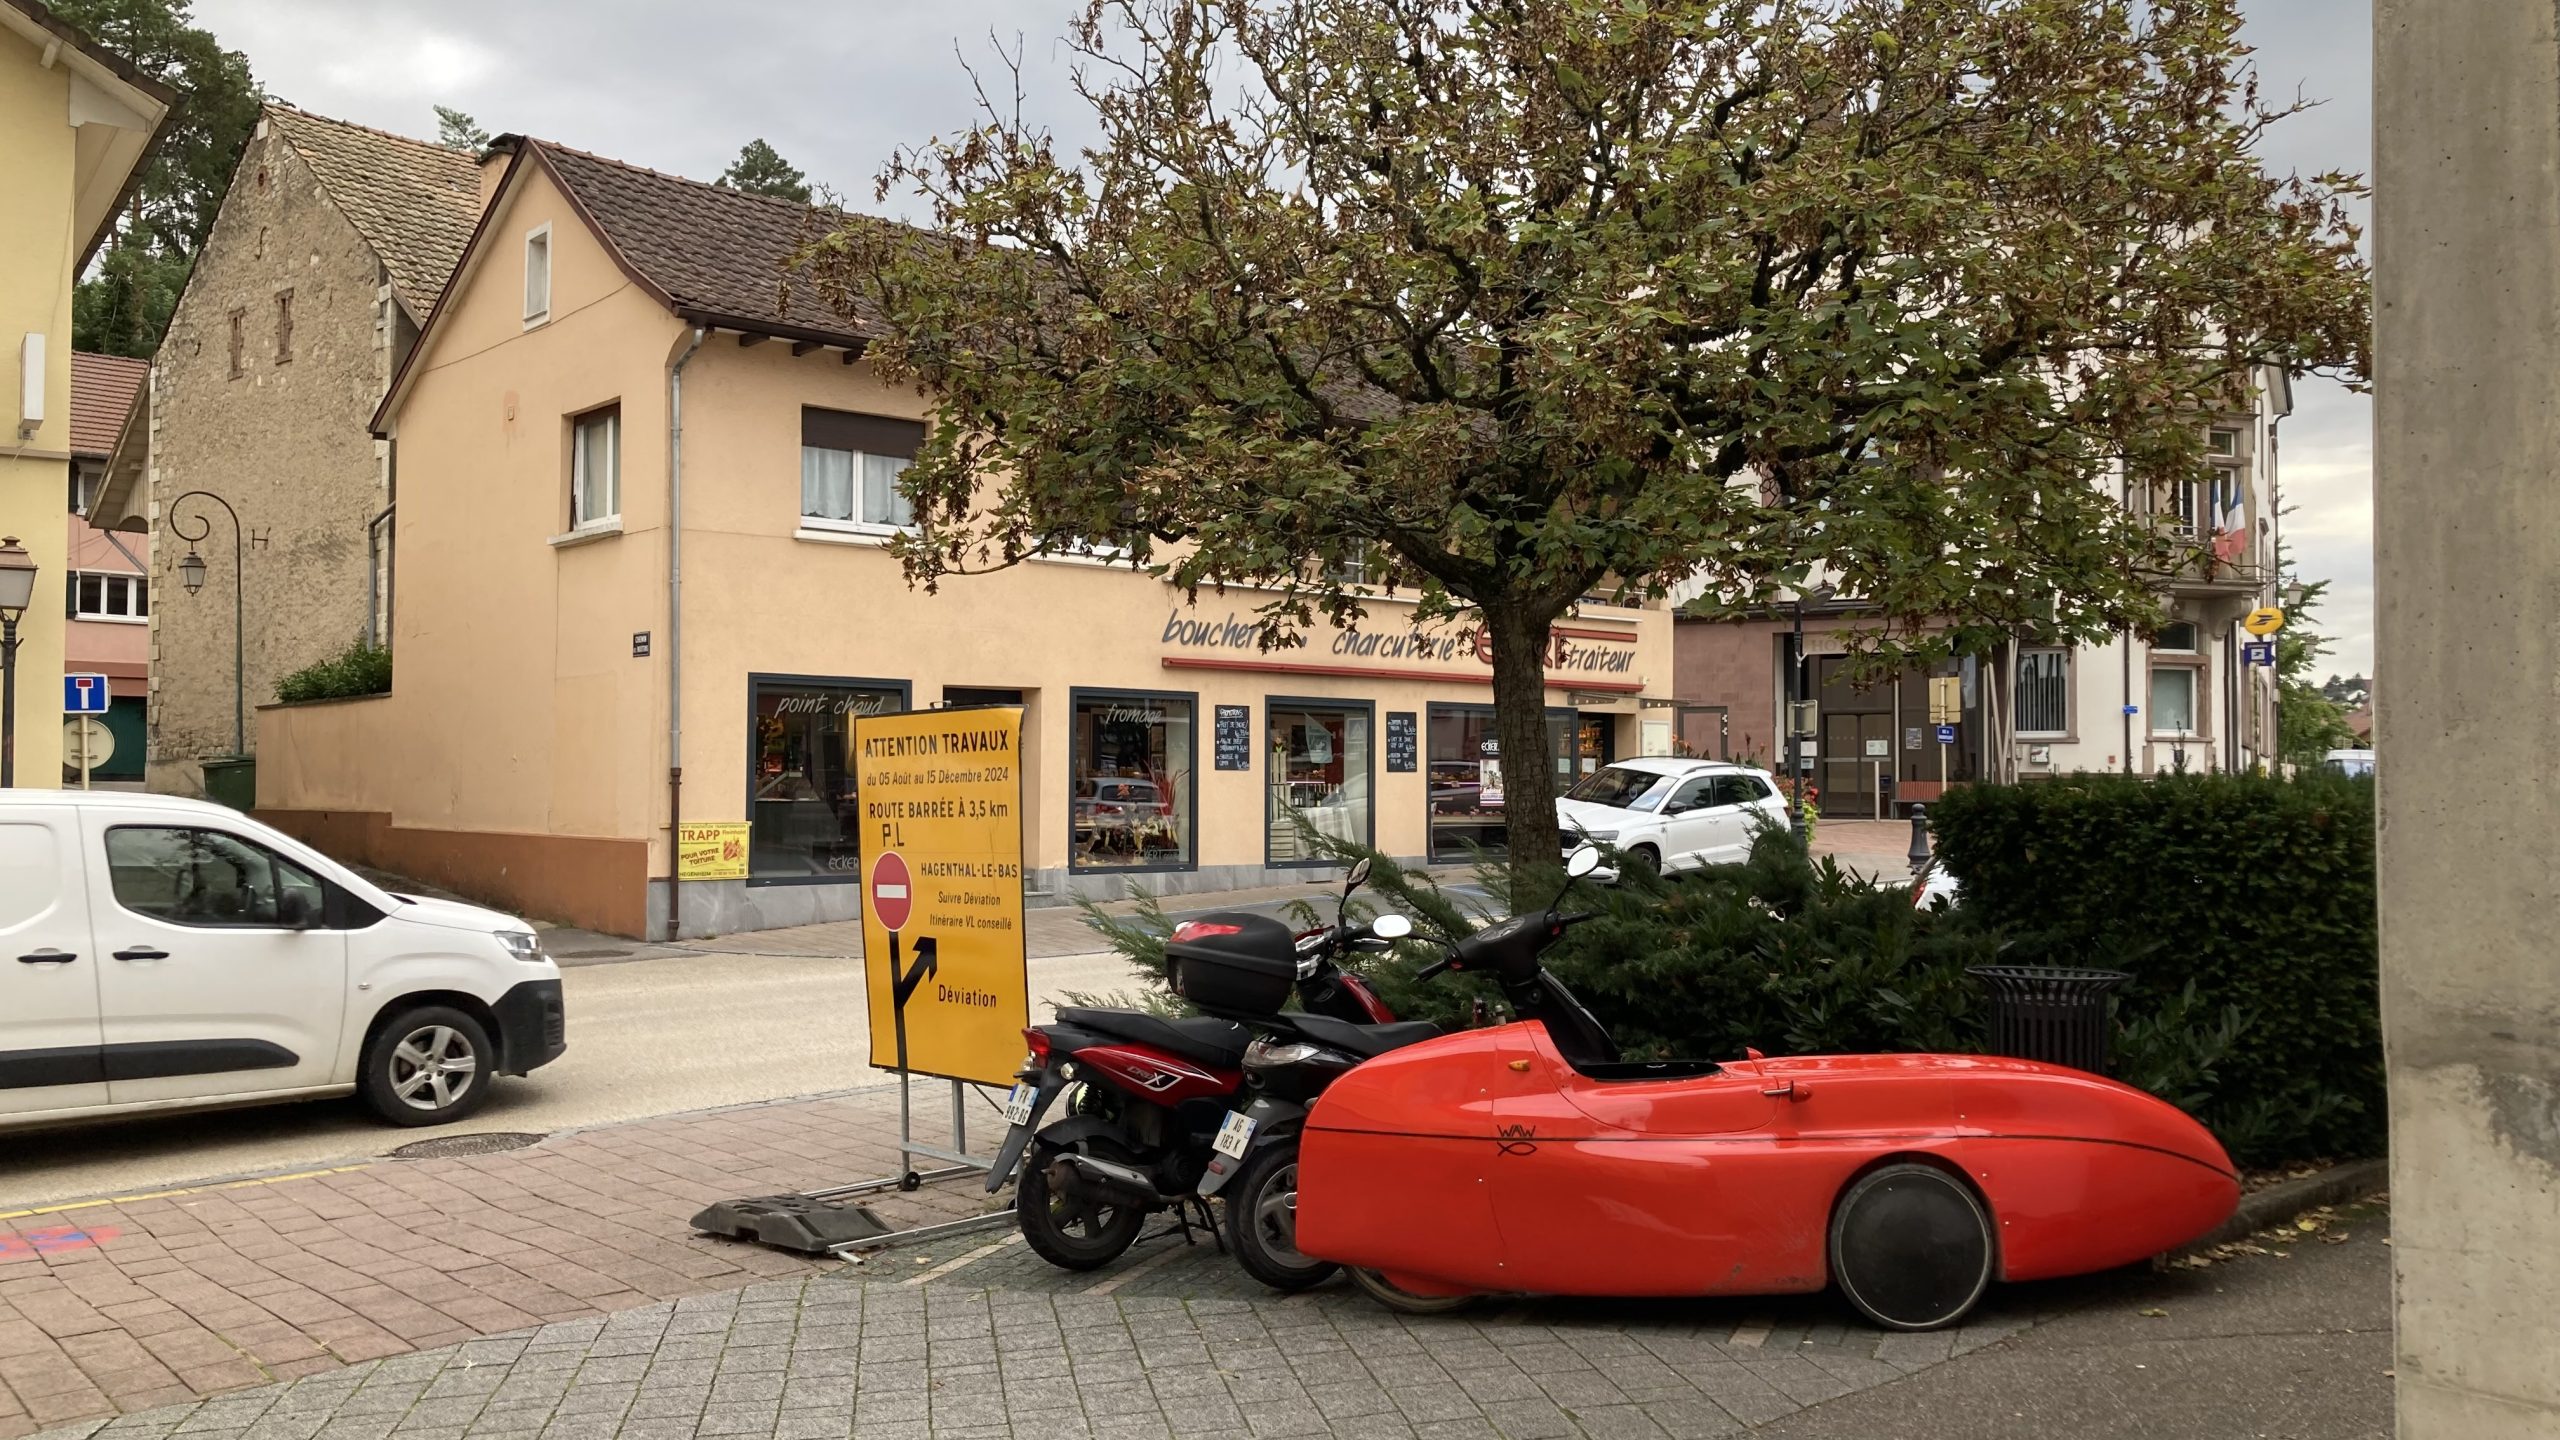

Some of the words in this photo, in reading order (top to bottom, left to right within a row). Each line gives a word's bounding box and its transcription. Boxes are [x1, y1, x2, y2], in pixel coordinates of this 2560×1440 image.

[1162, 607, 1308, 652] boucher
[1567, 644, 1636, 673] traiteur
[773, 693, 829, 719] point
[833, 694, 885, 716] chaud
[1105, 703, 1162, 728] fromage
[865, 734, 938, 757] ATTENTION
[942, 730, 1008, 753] TRAVAUX
[866, 774, 877, 787] du
[879, 771, 890, 786] 05
[892, 770, 912, 785] Août
[913, 773, 924, 785] au
[926, 769, 936, 784] 15
[938, 768, 982, 784] Décembre
[984, 766, 1008, 781] 2024
[869, 802, 905, 819] ROUTE
[908, 797, 954, 818] BARRÉE
[958, 797, 965, 817] À
[969, 799, 986, 820] 3,5
[989, 800, 1008, 817] km
[680, 830, 720, 840] TRAPP
[681, 852, 698, 860] POUR
[699, 847, 719, 856] VOTRE
[689, 855, 716, 865] TOITURE
[828, 855, 860, 870] ECKER
[920, 862, 1018, 878] HAGENTHAL-LE-BAS
[938, 890, 962, 905] Suivre
[963, 891, 1001, 906] Déviation
[929, 913, 964, 928] Itinéraire
[965, 915, 975, 928] VL
[977, 917, 1012, 931] conseillé
[939, 984, 996, 1008] Déviation
[1219, 1133, 1234, 1150] 183
